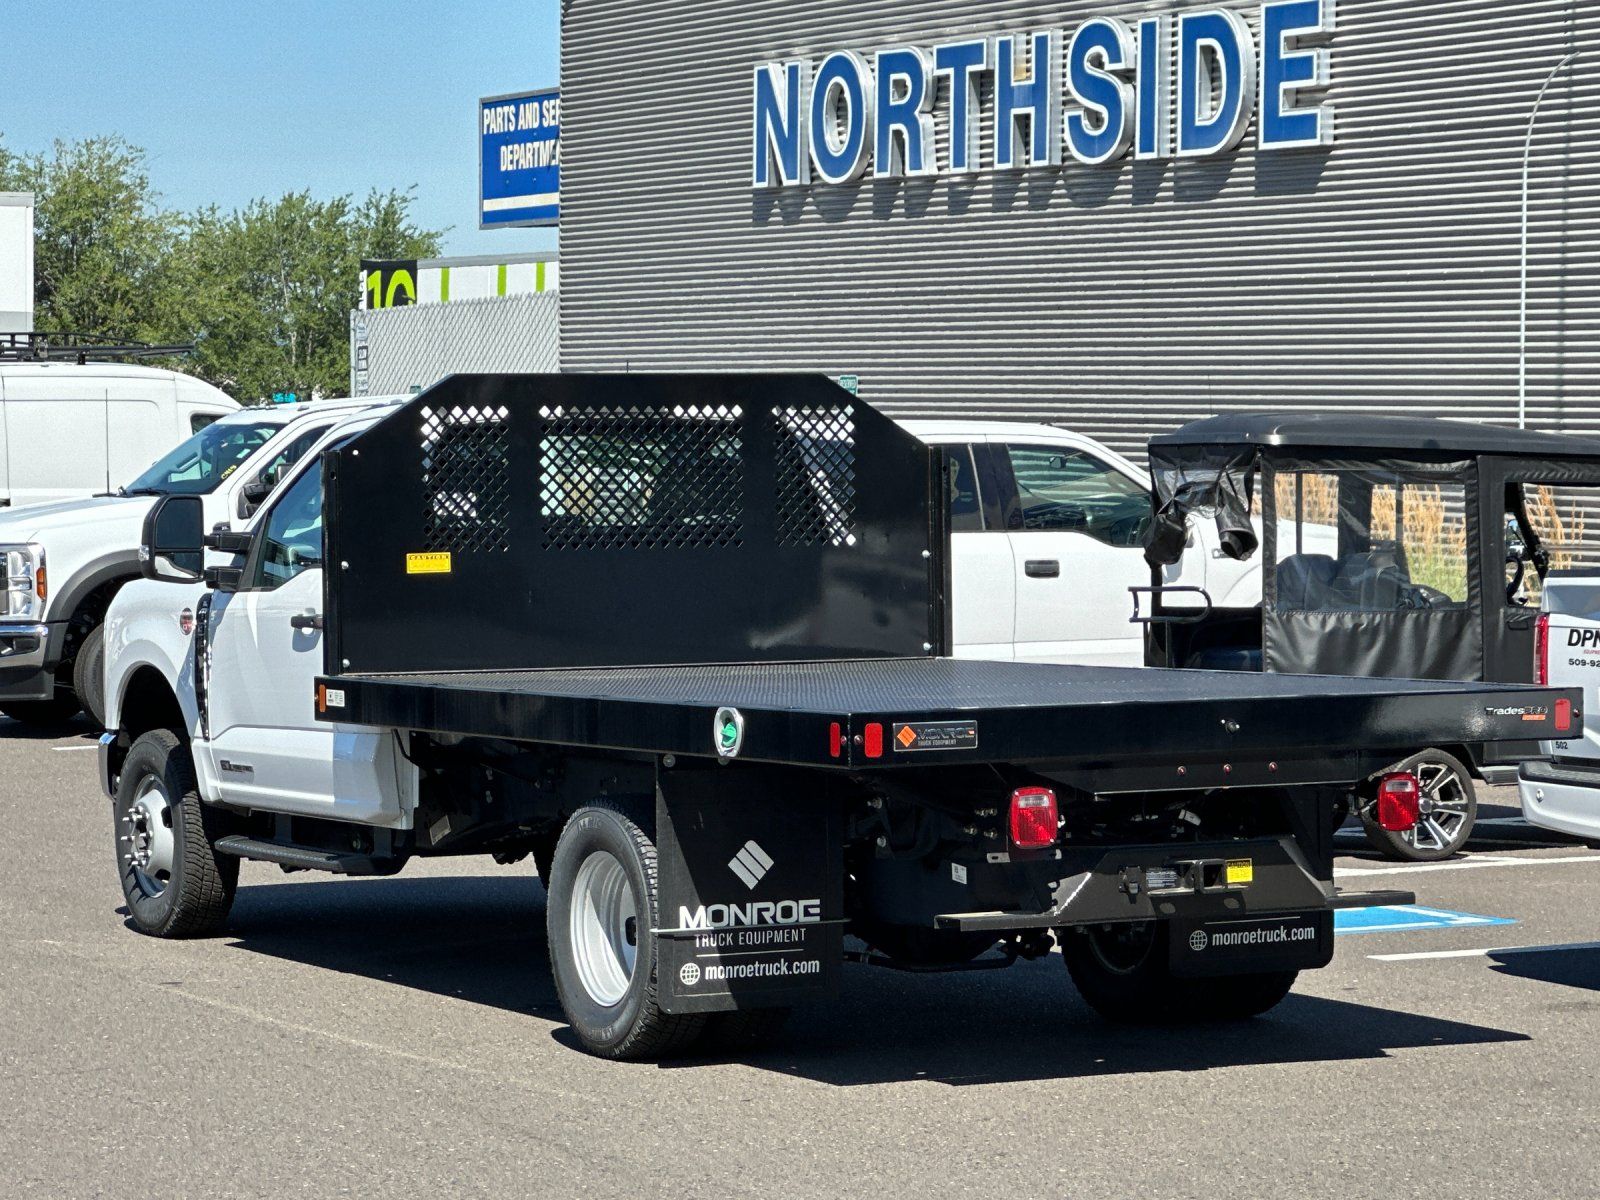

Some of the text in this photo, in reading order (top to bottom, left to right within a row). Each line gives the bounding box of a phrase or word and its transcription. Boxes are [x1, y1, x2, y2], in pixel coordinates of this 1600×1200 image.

[752, 0, 1328, 189] NORTHSIDE
[483, 104, 516, 135] PARTS
[518, 101, 540, 131] AND
[918, 727, 975, 740] MONROE
[679, 899, 821, 930] MONROE
[695, 927, 807, 948] TRUCK EQUIPMENT
[1212, 925, 1316, 947] monroetruck.com
[705, 958, 820, 980] monroetruck.com
